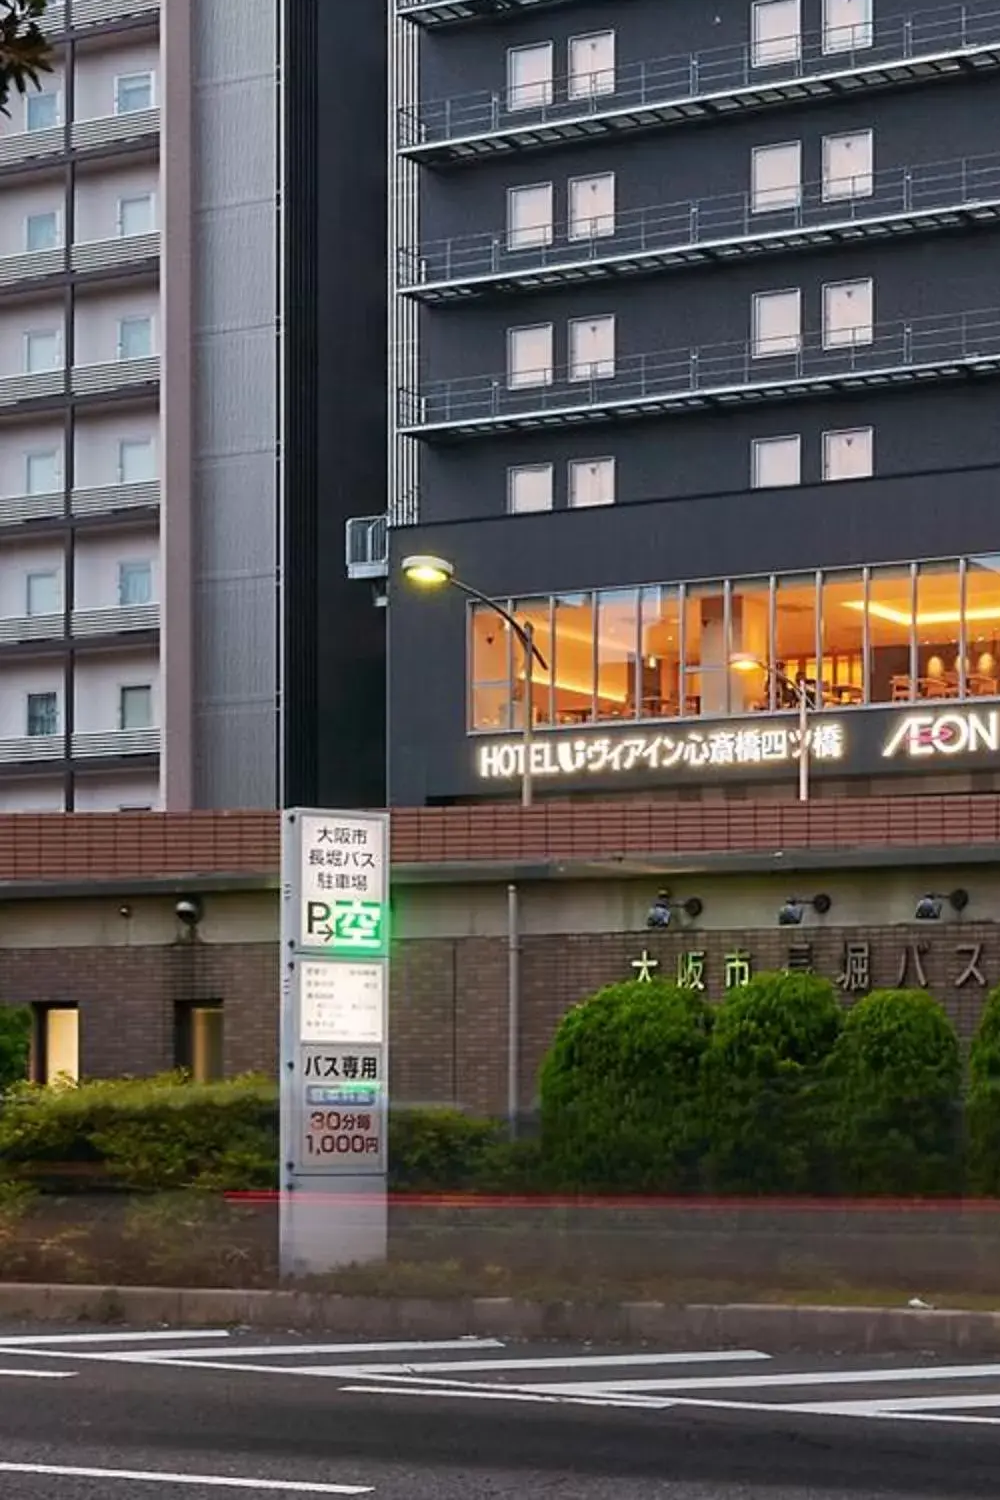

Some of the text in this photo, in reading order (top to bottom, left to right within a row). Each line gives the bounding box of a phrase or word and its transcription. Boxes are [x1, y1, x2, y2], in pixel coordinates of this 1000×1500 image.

[479, 741, 559, 778] HOTEL
[317, 827, 368, 845] 大阪市
[309, 849, 376, 868] 長堀バス
[317, 873, 368, 891] 駐車場
[307, 901, 331, 934] P
[304, 1055, 377, 1079] バス専用
[305, 1134, 379, 1156] 1,000円
